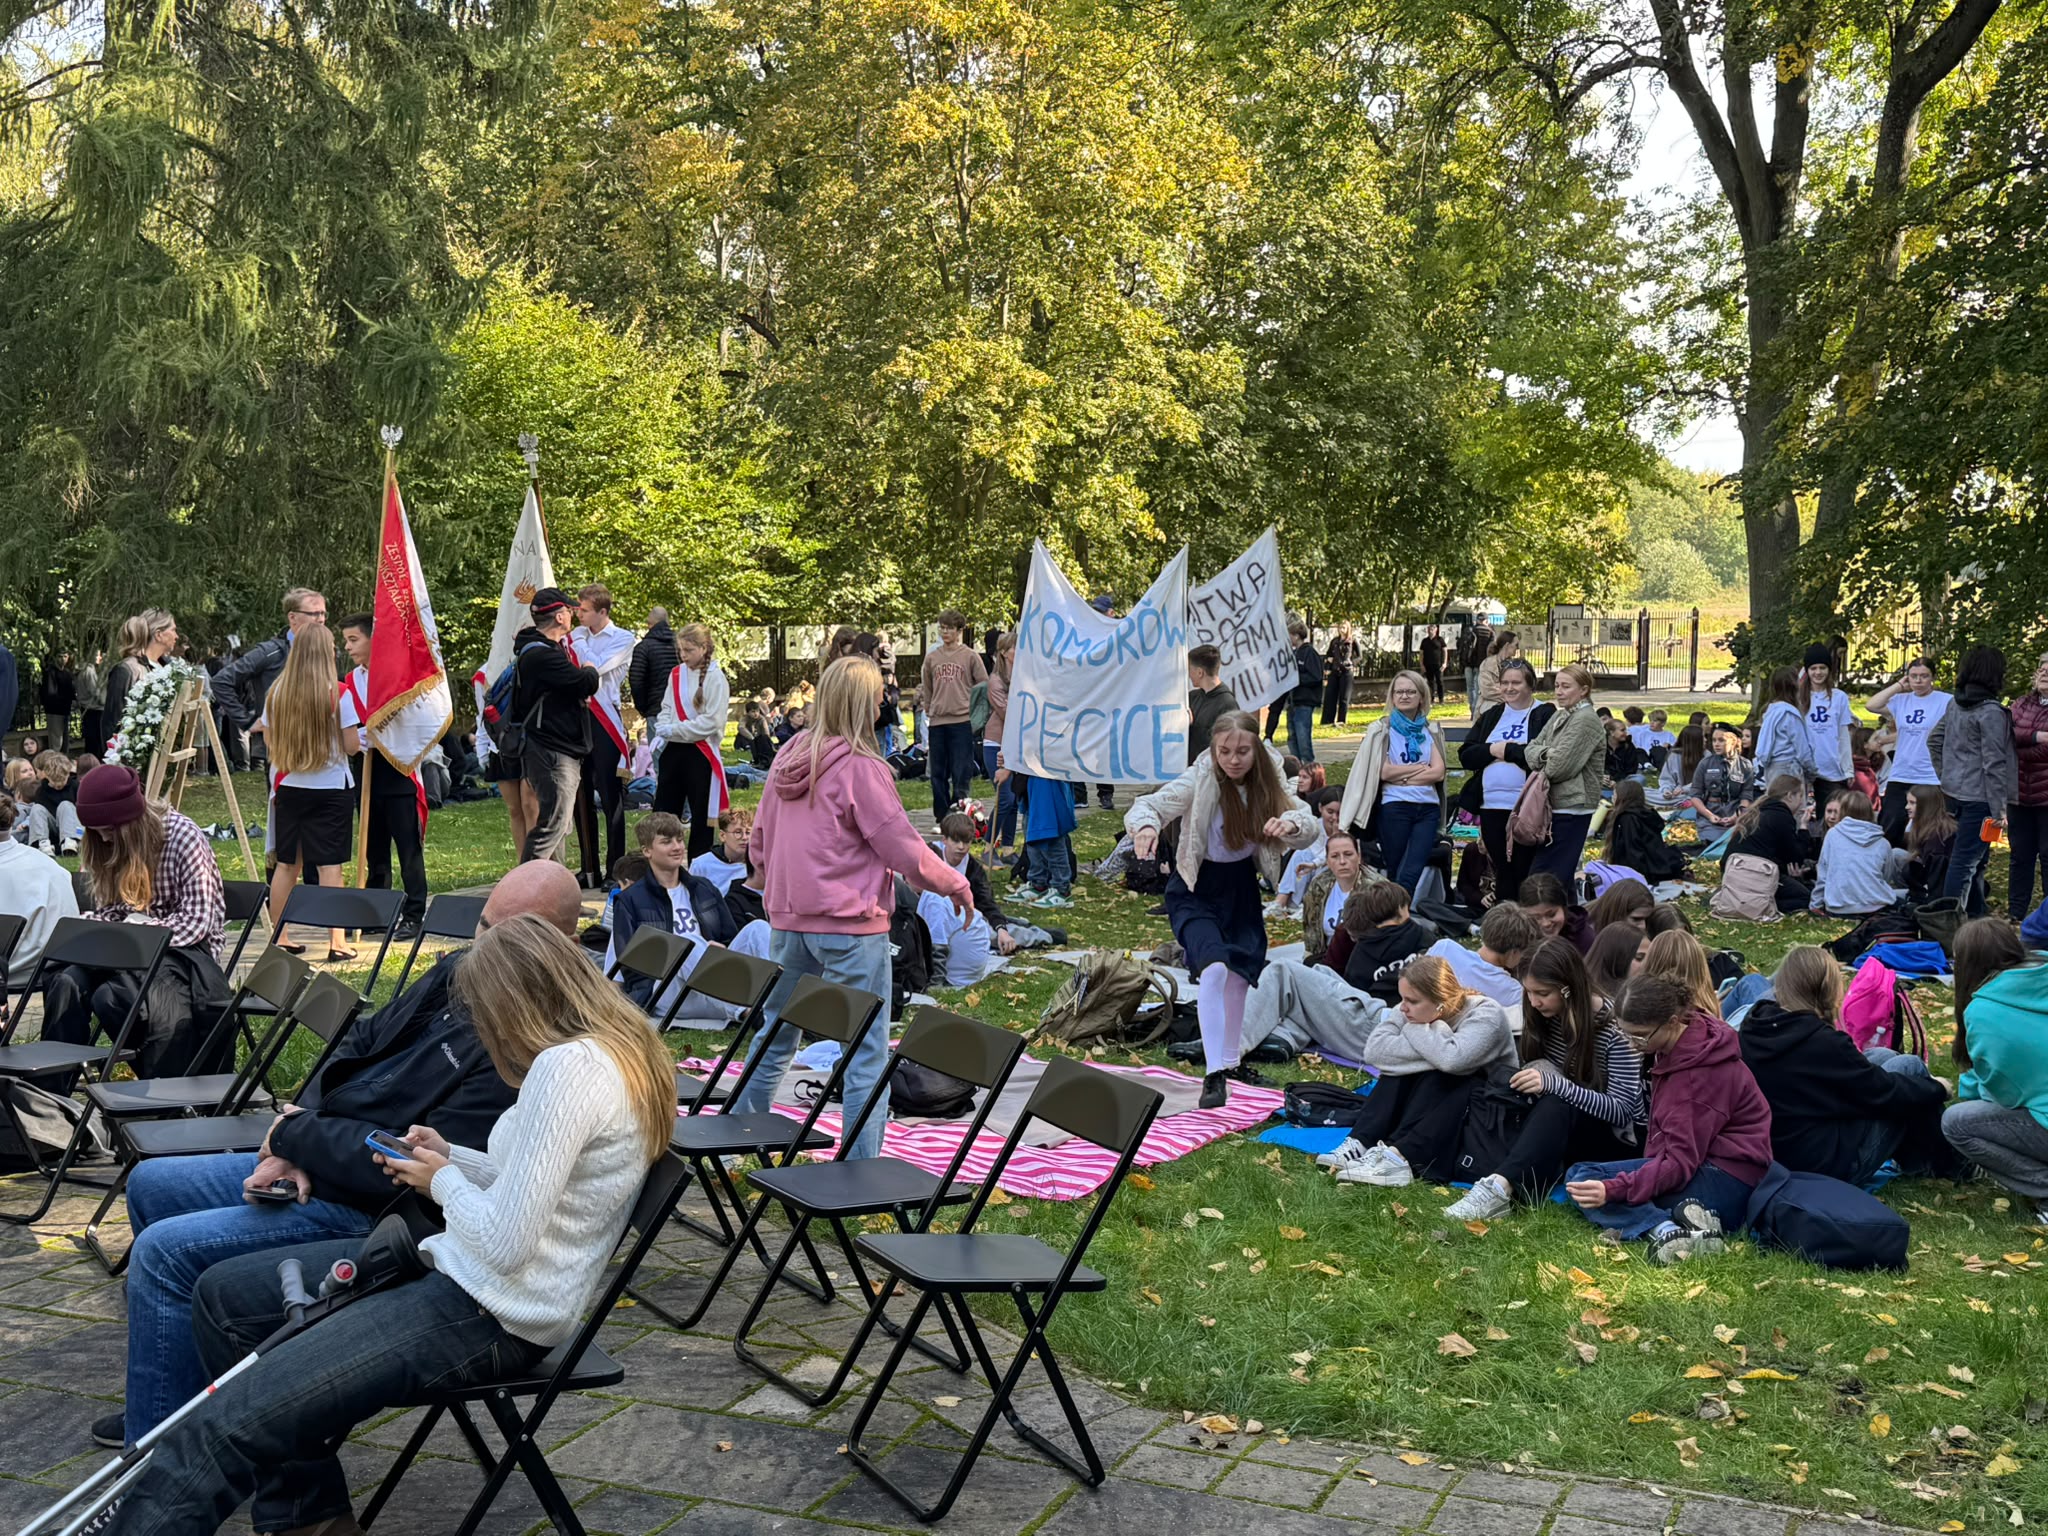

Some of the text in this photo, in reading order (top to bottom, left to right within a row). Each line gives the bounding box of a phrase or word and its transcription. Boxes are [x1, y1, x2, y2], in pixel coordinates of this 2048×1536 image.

[513, 539, 537, 557] NA
[1190, 562, 1266, 626] ITWA
[1019, 594, 1187, 667] KOMORÓW
[1219, 612, 1278, 666] CAMI
[1268, 638, 1298, 683] 194
